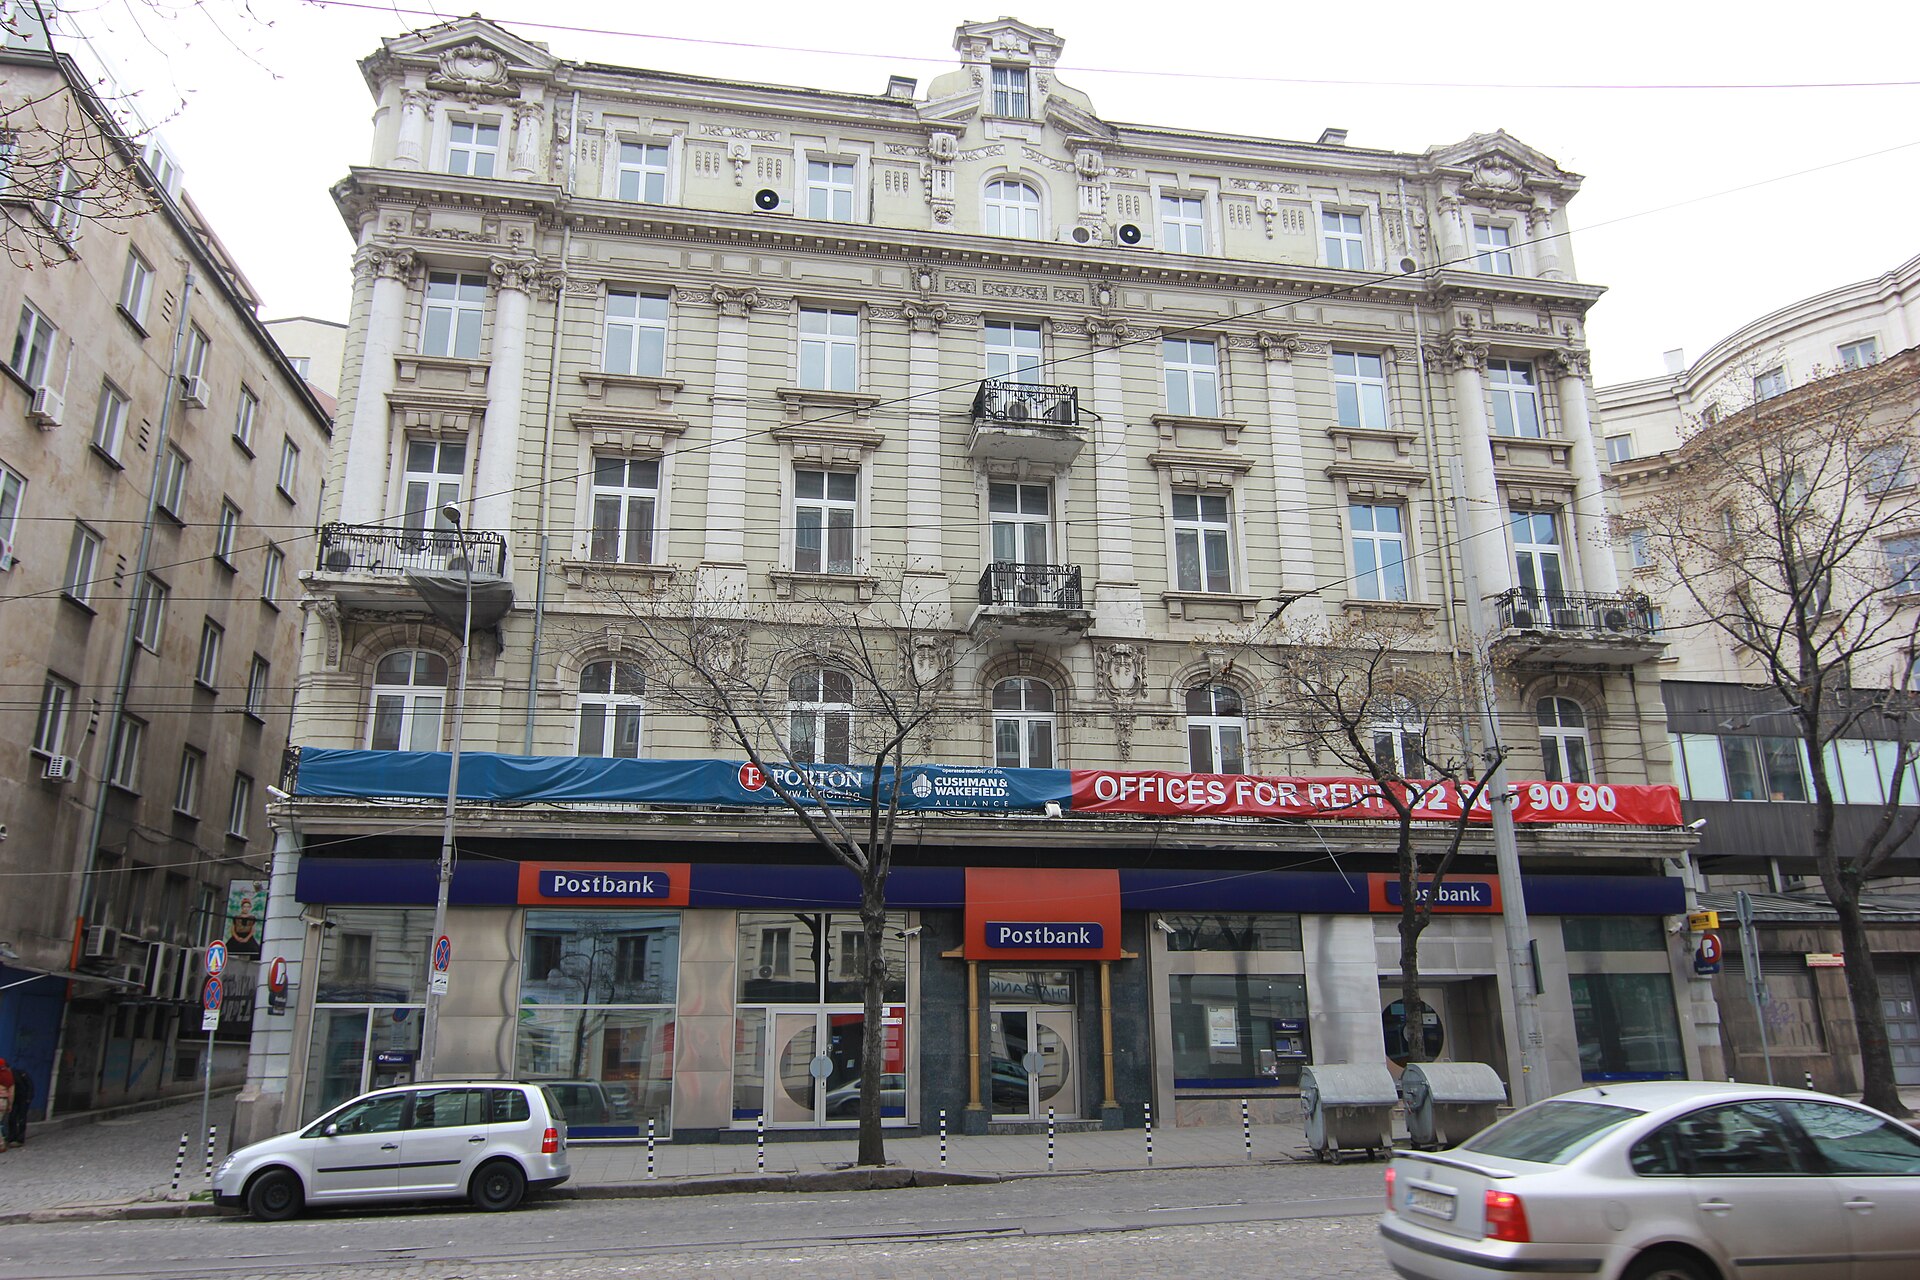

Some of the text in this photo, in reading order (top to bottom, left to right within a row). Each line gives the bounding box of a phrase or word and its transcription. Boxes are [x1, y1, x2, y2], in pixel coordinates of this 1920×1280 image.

[772, 768, 864, 789] FORTON
[934, 777, 1008, 788] CUSHMAN &
[934, 786, 1006, 797] WAKEFIELD
[1094, 775, 1227, 805] OFFICES
[1236, 781, 1300, 807] FOR
[1308, 783, 1385, 809] RENT
[1406, 782, 1448, 810] 02
[1529, 783, 1569, 812] 90
[1578, 785, 1616, 813] 90
[935, 799, 1009, 807] ALLIANCE
[554, 875, 655, 893] Postbank
[1401, 886, 1481, 902] sbank
[1000, 926, 1091, 944] Postbank
